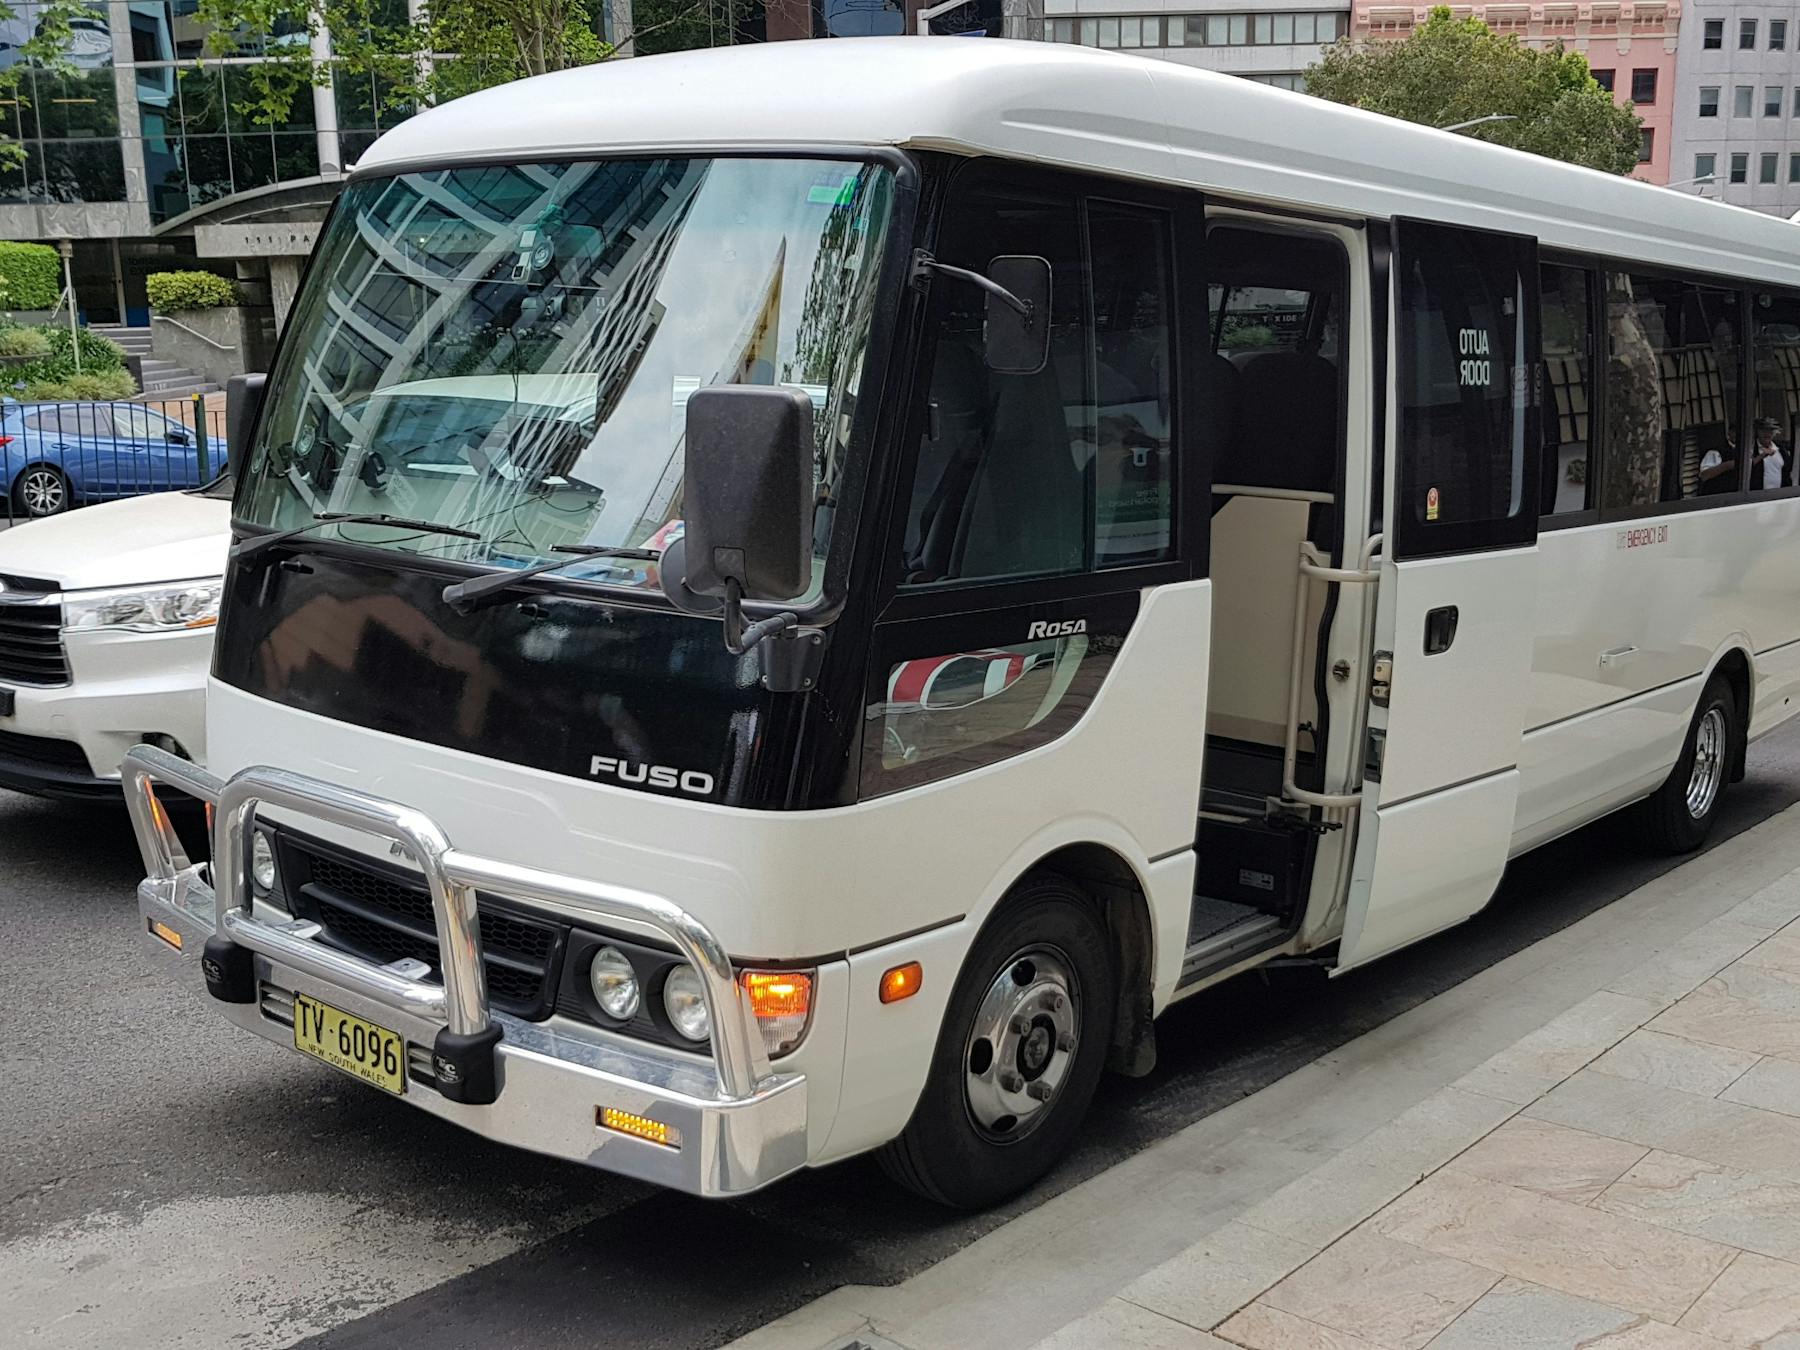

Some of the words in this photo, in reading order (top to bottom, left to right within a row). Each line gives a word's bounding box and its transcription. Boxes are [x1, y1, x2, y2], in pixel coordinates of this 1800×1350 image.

[1658, 525, 1668, 543] EXIT
[1027, 619, 1087, 640] ROSA
[590, 755, 714, 794] FUSO
[308, 1043, 325, 1057] NEW
[329, 1052, 356, 1073] SOUTH
[361, 1067, 386, 1086] WALES
